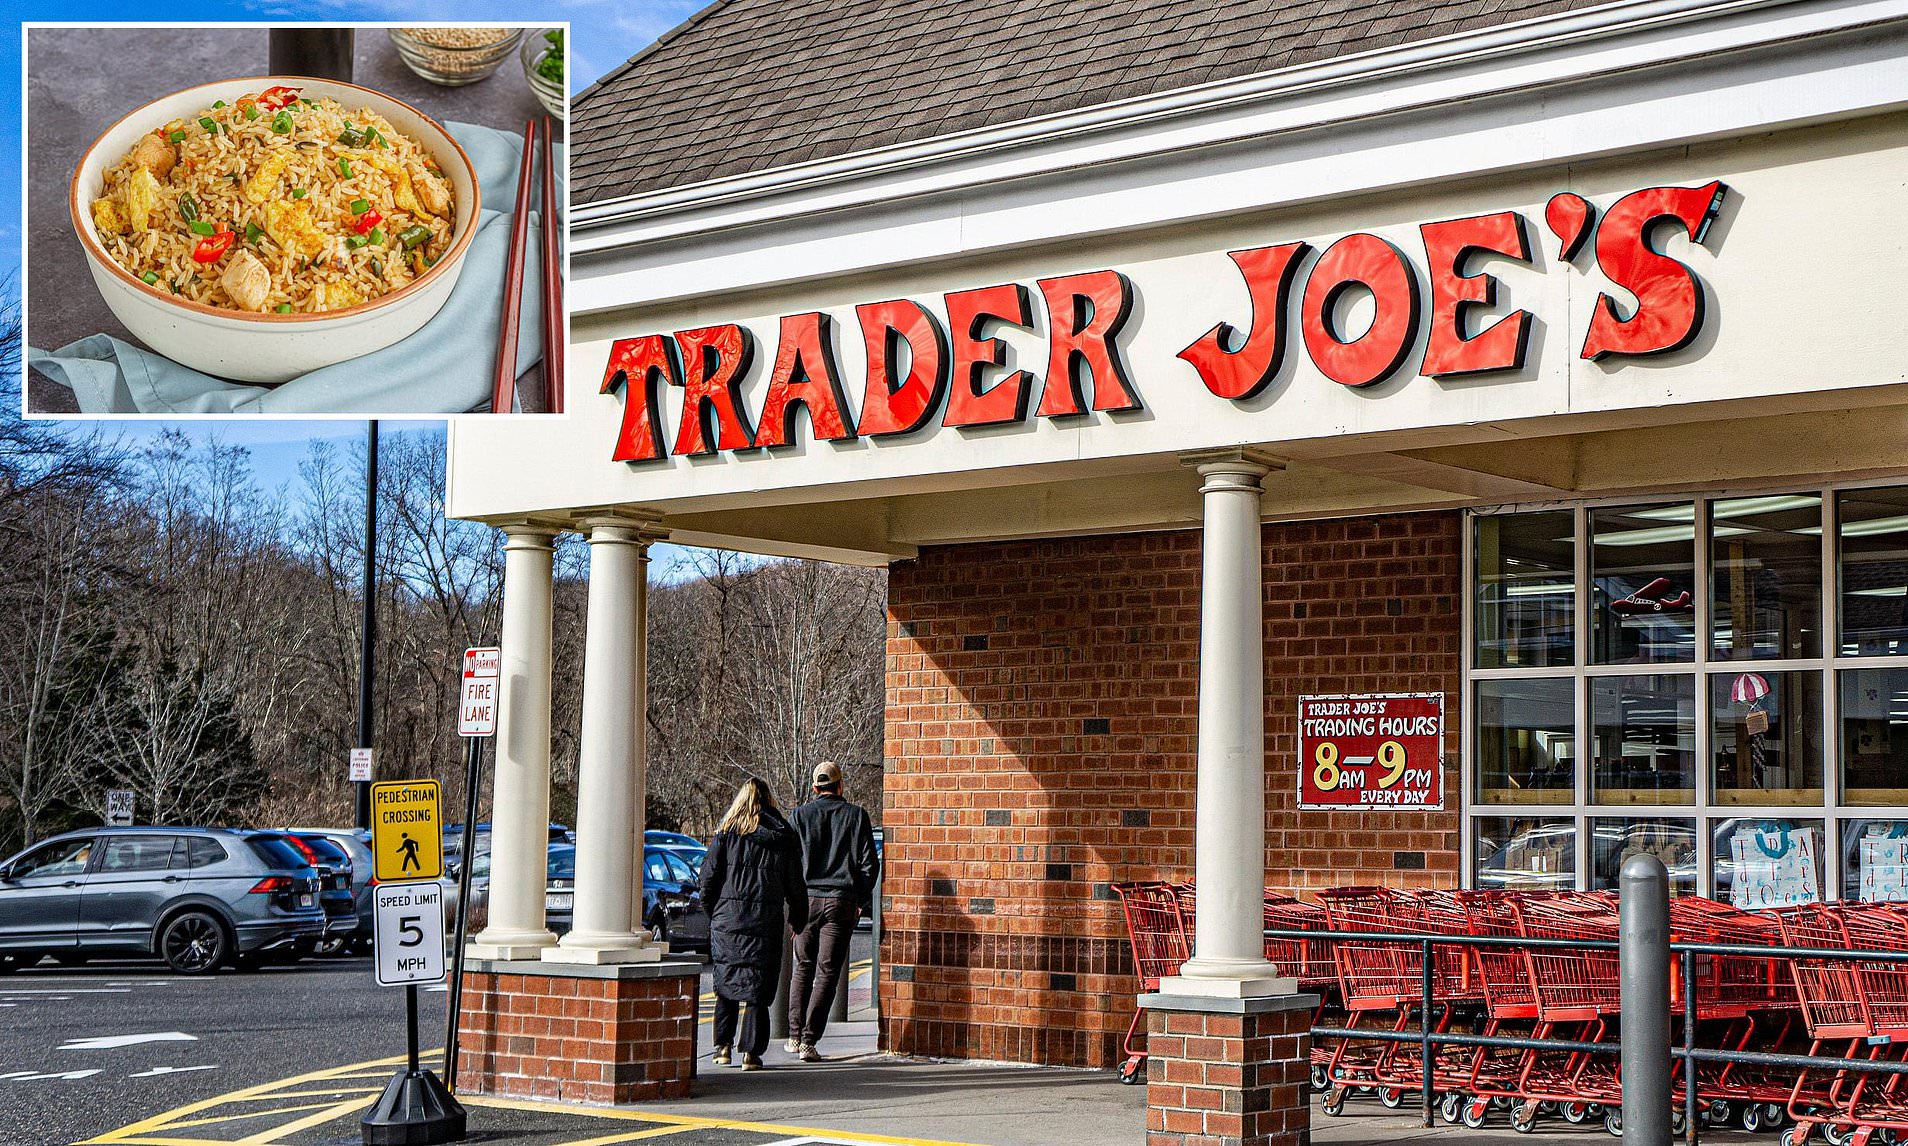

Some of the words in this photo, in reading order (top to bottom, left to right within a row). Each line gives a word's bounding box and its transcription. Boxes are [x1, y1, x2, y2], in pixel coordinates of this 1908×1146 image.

[599, 270, 1143, 461] TRADER
[1176, 180, 1727, 400] JOE'S
[465, 656, 475, 672] NO
[475, 659, 497, 669] PARKING
[468, 684, 491, 699] FIRE
[465, 706, 491, 721] LANE
[1308, 703, 1351, 715] TRADER
[1352, 701, 1387, 714] JOE'S
[1304, 718, 1376, 737] TRADING
[1379, 716, 1438, 736] HOURS
[112, 792, 130, 802] ONE
[377, 789, 434, 804] PEDESTRIAN
[1360, 790, 1402, 803] EVERY
[1403, 790, 1430, 803] DAY
[110, 803, 130, 812] WAY
[383, 809, 431, 824] CROSSING
[380, 896, 411, 908] SPEED
[415, 894, 438, 905] LIMIT
[399, 915, 424, 947] 5
[397, 957, 426, 971] MPH
